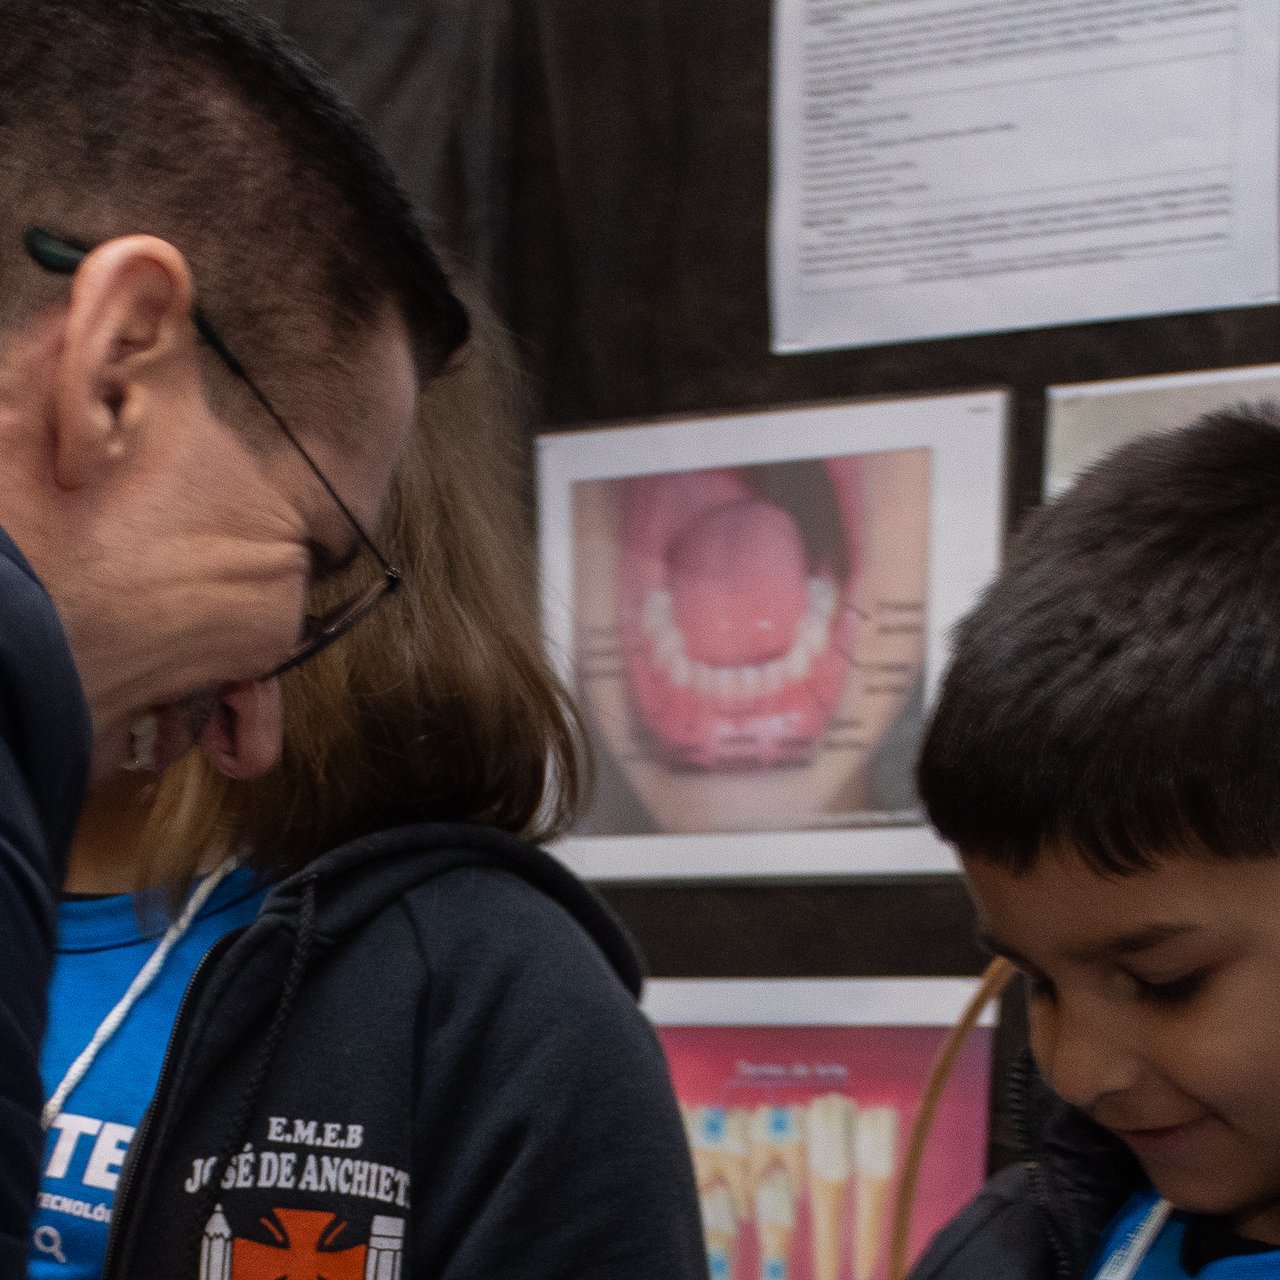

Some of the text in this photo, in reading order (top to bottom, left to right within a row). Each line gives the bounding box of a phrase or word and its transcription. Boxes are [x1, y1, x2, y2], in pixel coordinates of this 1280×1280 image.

[42, 1111, 137, 1191] TE
[257, 1151, 297, 1189] DE
[298, 1153, 412, 1209] ANCHIET
